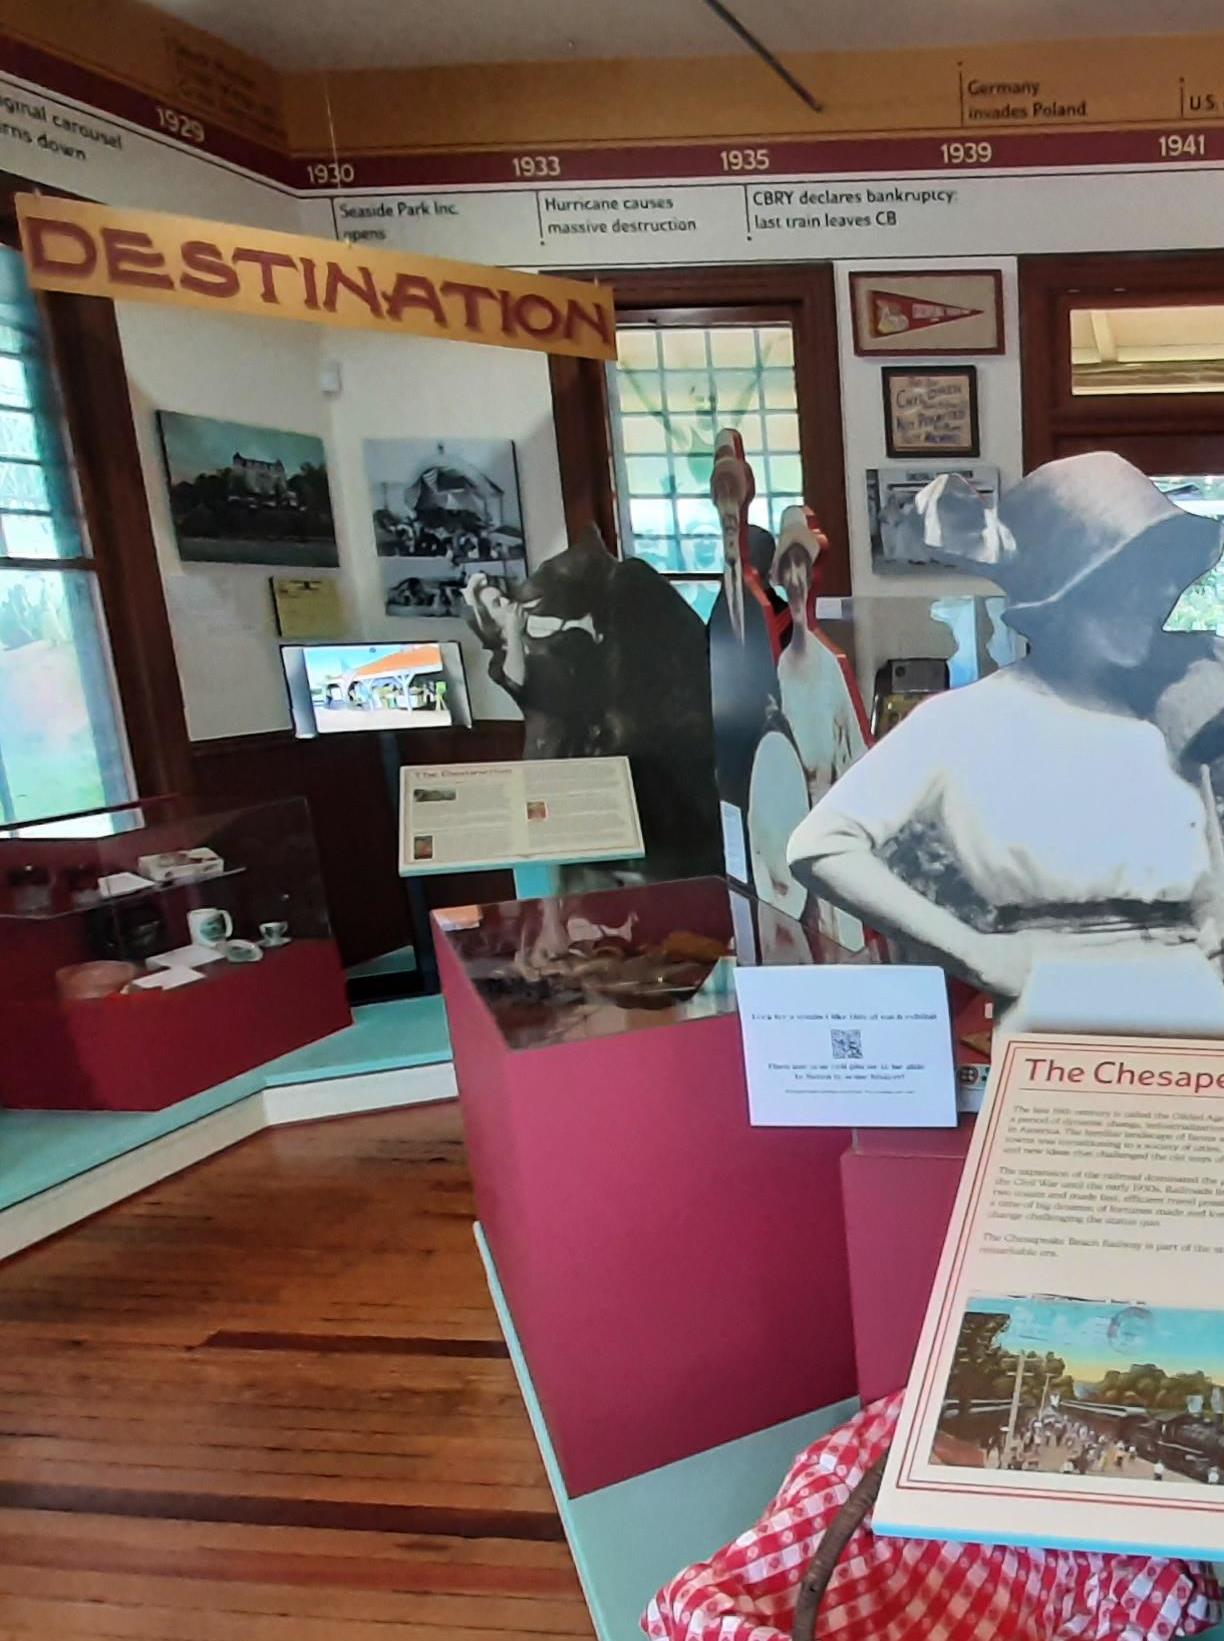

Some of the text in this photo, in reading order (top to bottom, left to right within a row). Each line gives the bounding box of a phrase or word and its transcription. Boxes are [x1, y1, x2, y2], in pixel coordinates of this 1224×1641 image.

[968, 79, 1040, 97] Germany
[968, 100, 1087, 120] invades Poland
[52, 114, 122, 149] carousel
[157, 107, 205, 142] 1929
[37, 133, 86, 160] down
[940, 142, 992, 164] 1939
[1158, 134, 1206, 157] 1941
[512, 156, 561, 177] 1933
[720, 149, 770, 171] 1935
[307, 163, 354, 184] 1930
[545, 197, 673, 212] Hurricane causes
[753, 190, 794, 206] CBRY
[799, 190, 861, 205] declares
[339, 201, 393, 218] Seaside
[397, 201, 429, 216] Park
[754, 211, 897, 229] last train leaves CB
[548, 218, 697, 234] massive destruction
[25, 216, 612, 346] DESTINATION
[1025, 1058, 1085, 1083] The
